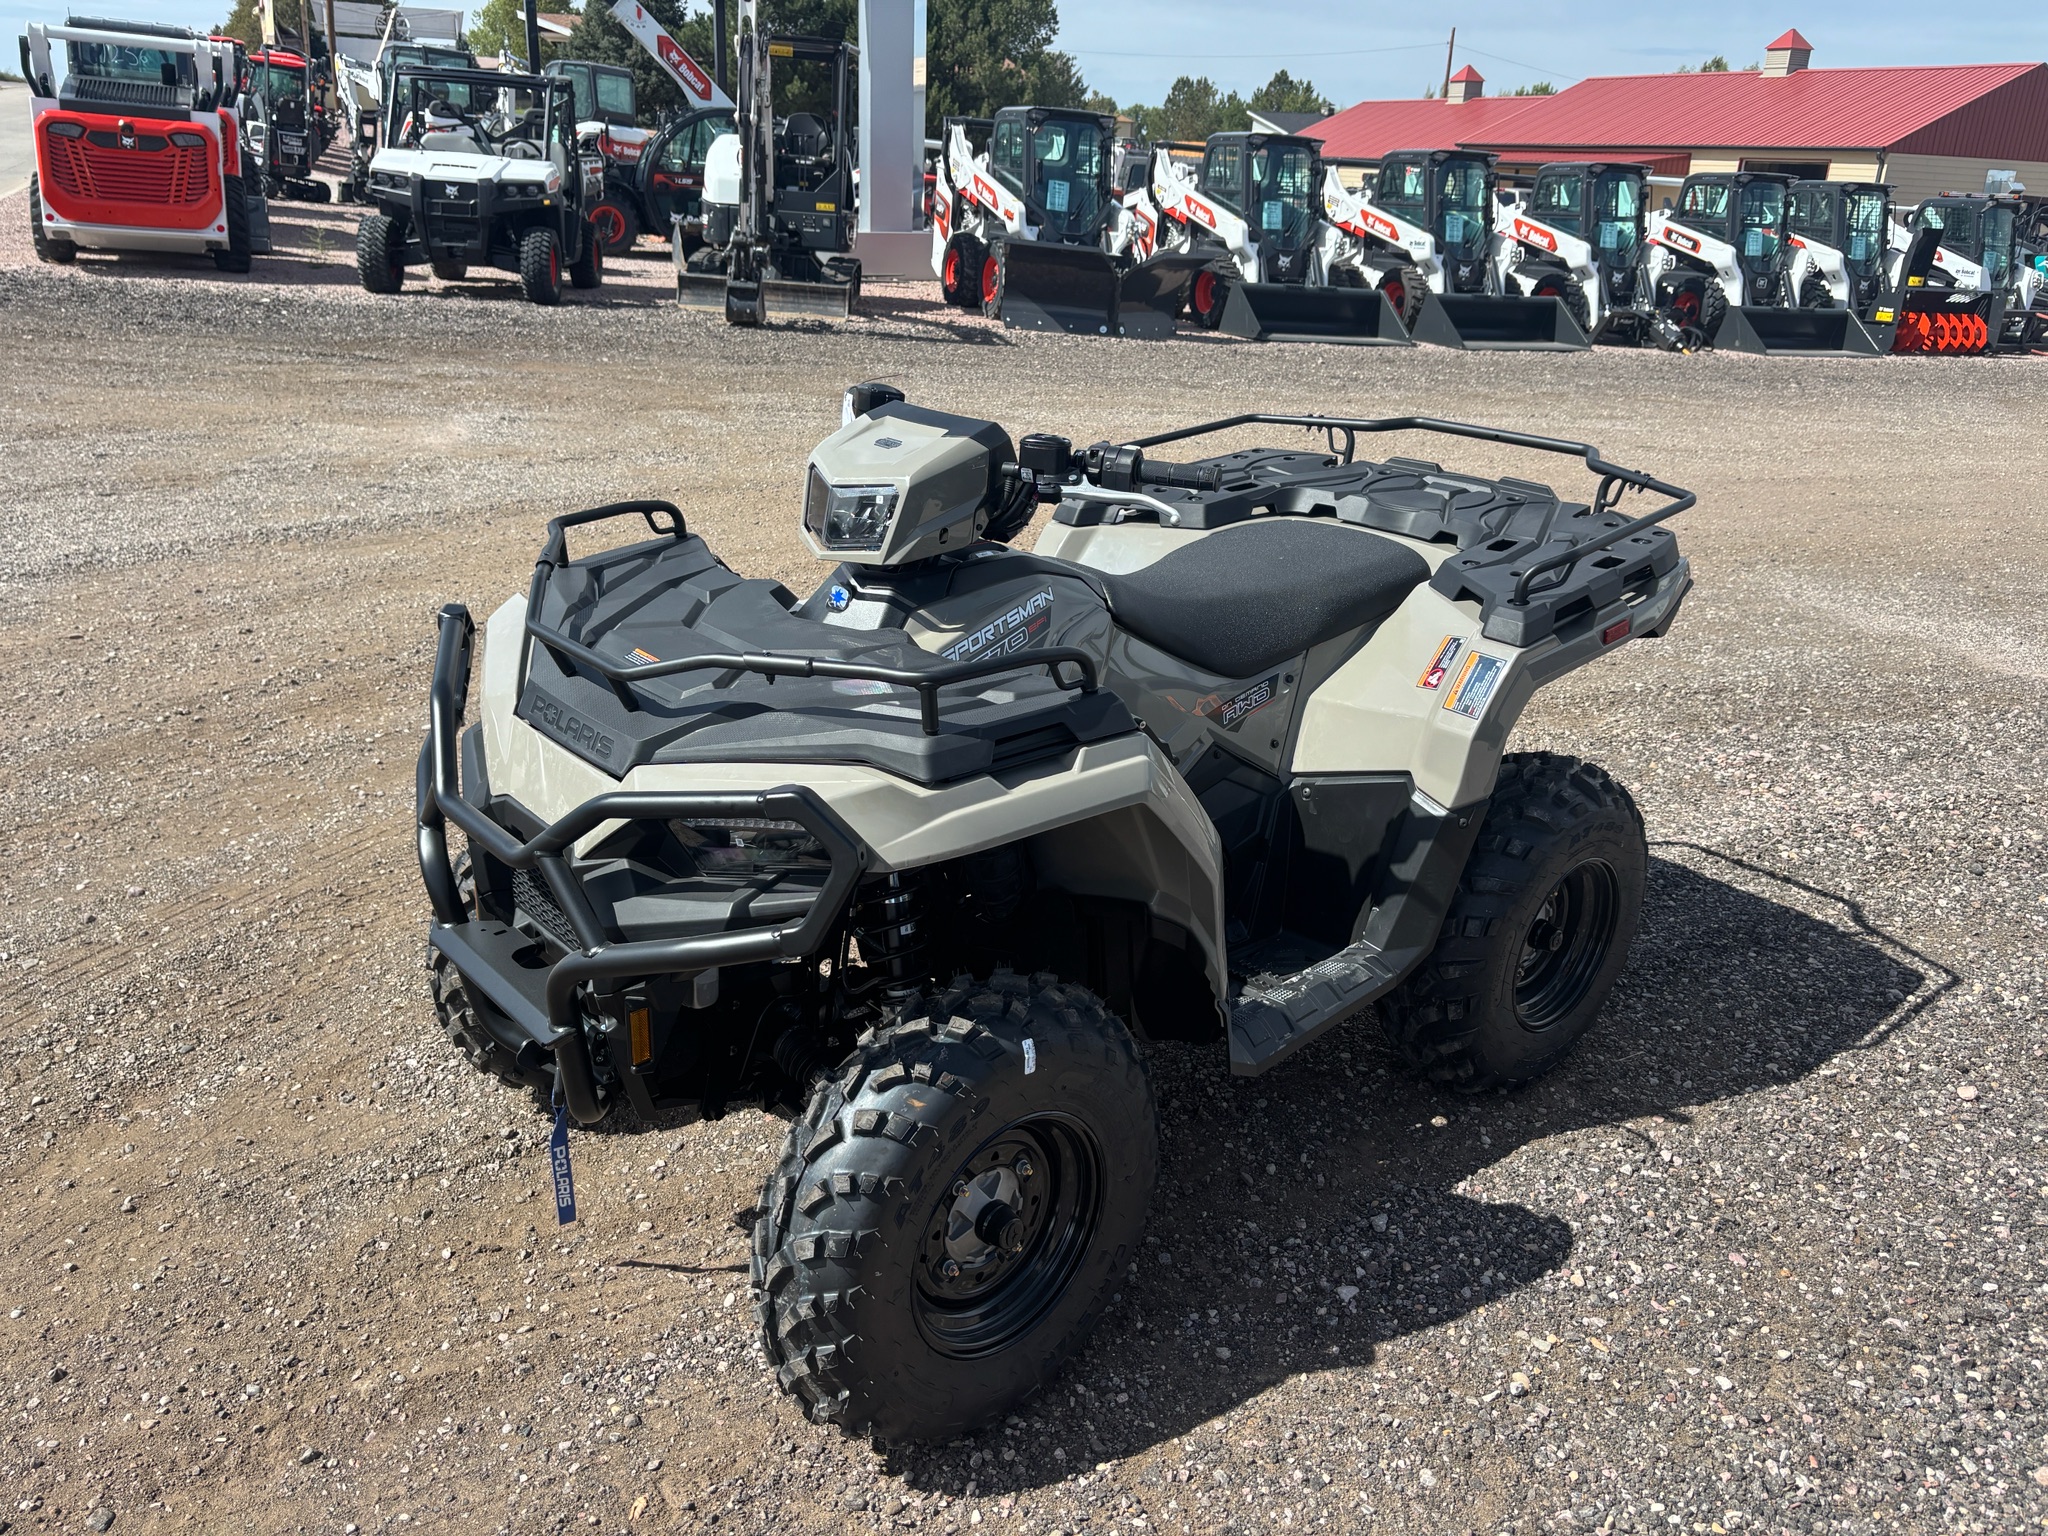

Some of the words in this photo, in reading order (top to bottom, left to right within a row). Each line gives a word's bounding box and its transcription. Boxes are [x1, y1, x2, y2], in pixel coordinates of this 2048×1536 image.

[678, 63, 705, 93] Bobcat
[1528, 230, 1550, 248] Bobcat
[941, 586, 1054, 661] SPORTSMAN
[1028, 616, 1048, 634] EFI
[1457, 665, 1471, 690] WARNING
[1222, 687, 1270, 725] AWD
[529, 694, 616, 760] POLARIS
[553, 1145, 572, 1208] POLARIS
